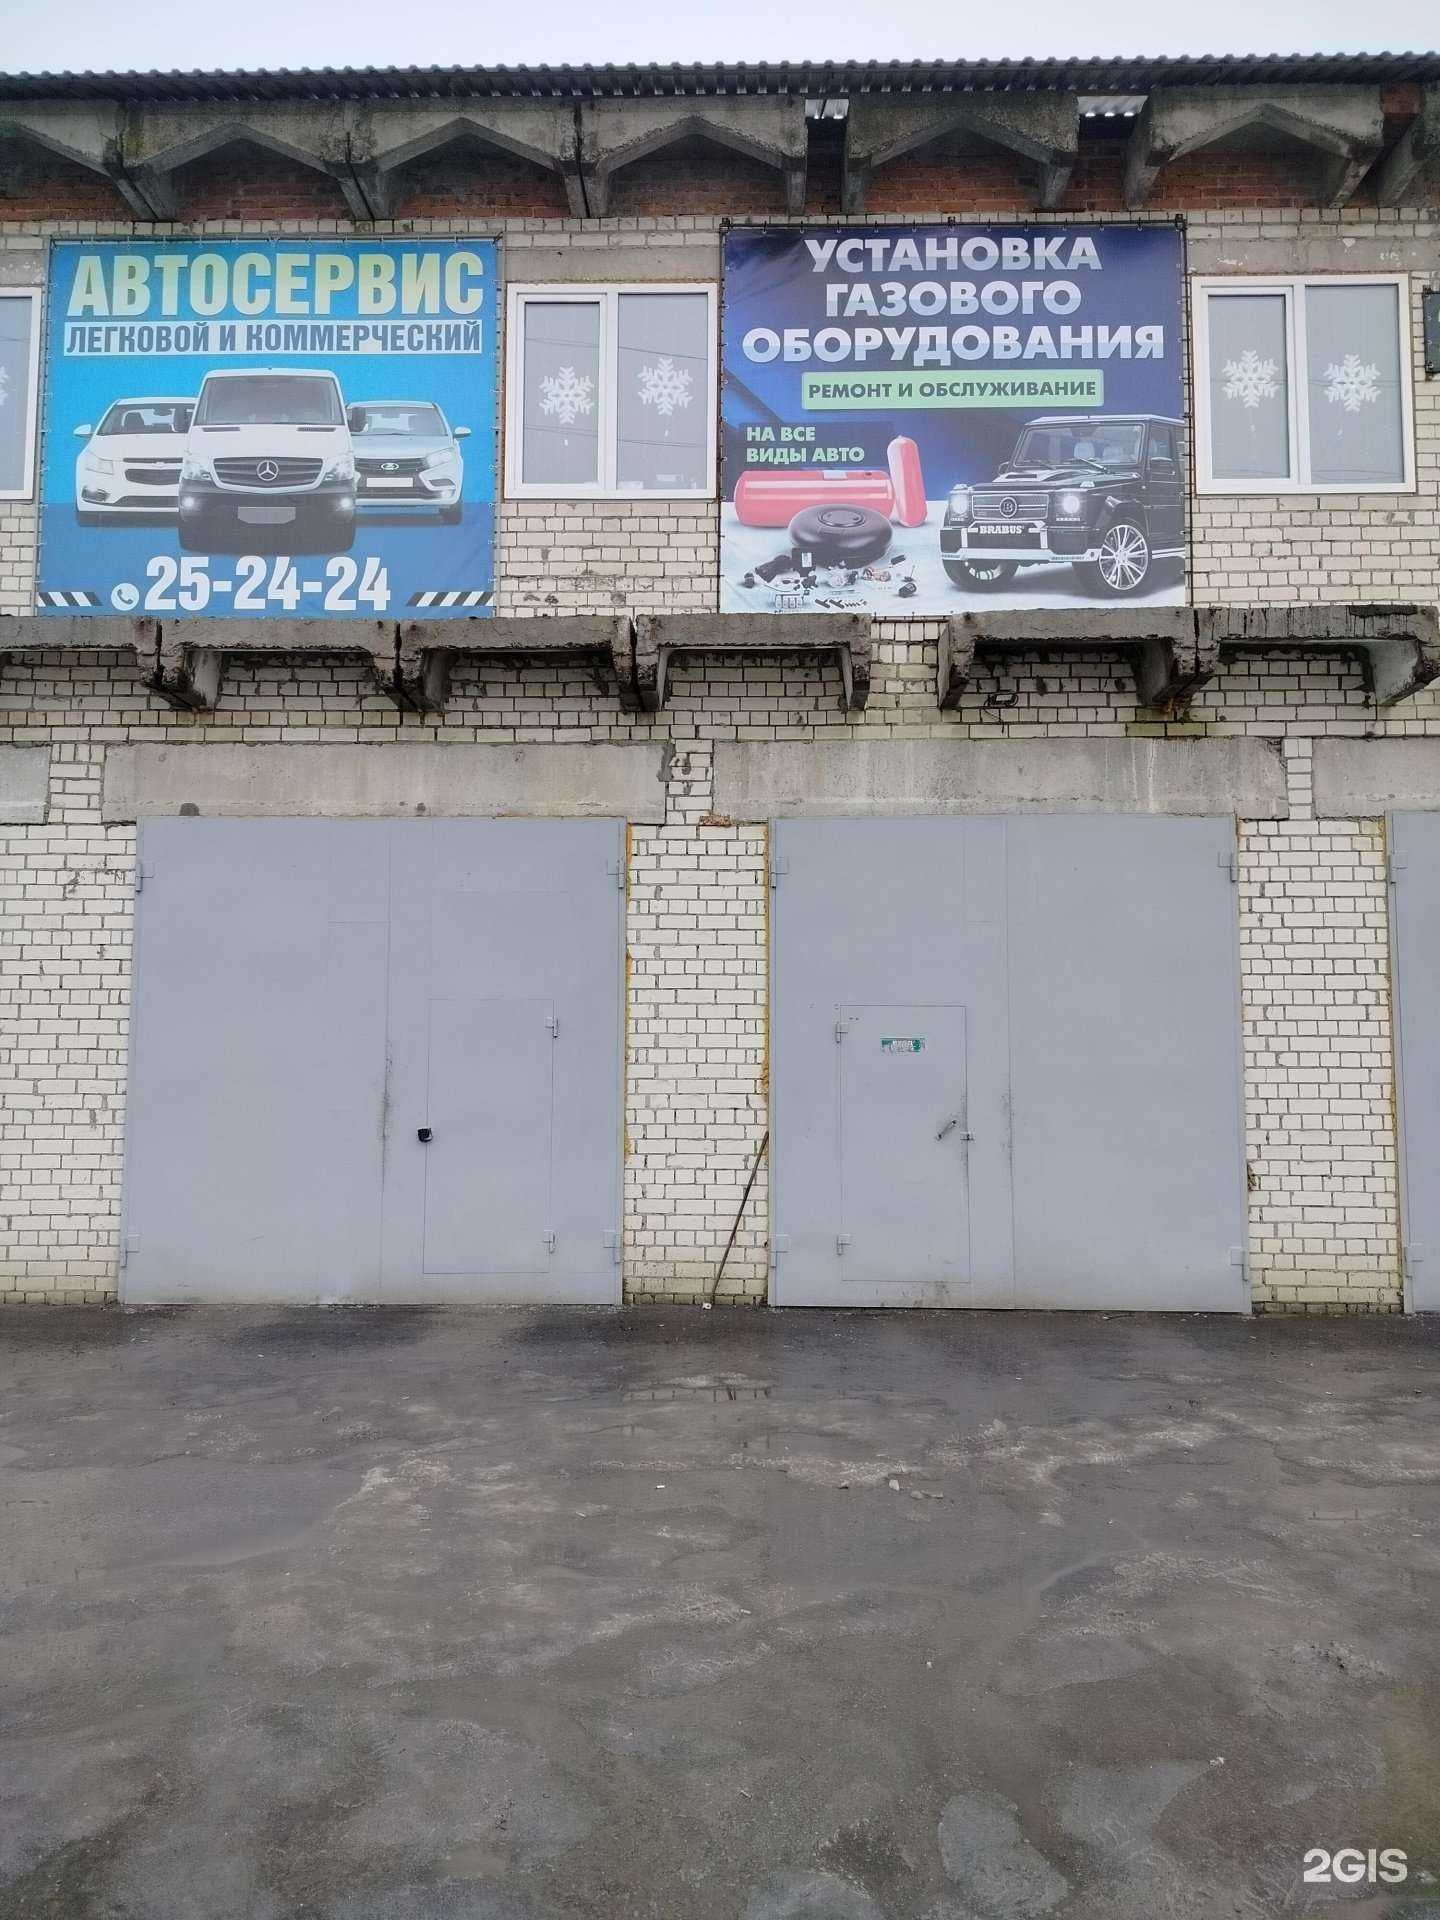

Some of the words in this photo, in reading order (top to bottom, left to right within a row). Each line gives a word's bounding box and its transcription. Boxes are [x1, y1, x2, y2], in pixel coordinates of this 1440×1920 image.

[805, 236, 1102, 273] УСТАНОВКА
[66, 253, 484, 316] АВТОСЕРВИС
[825, 281, 1082, 317] ГАЗОВОГО
[66, 321, 210, 354] ЛЕГКОВОЙ
[219, 326, 237, 352] И
[245, 320, 481, 352] КОММЕРЧЕСКИЙ
[742, 325, 1164, 367] ОБОРУДОВАНИЯ
[808, 383, 892, 399] РЕМОНТ
[898, 383, 913, 398] И
[918, 381, 1097, 398] ОБСЛУЖИВАНИЕ
[746, 428, 775, 442] НА
[780, 427, 816, 442] ВСЕ
[746, 449, 807, 464] ВИДЫ
[812, 447, 865, 462] АВТО
[979, 525, 1023, 534] BRABUS
[144, 556, 391, 611] 25-24-24
